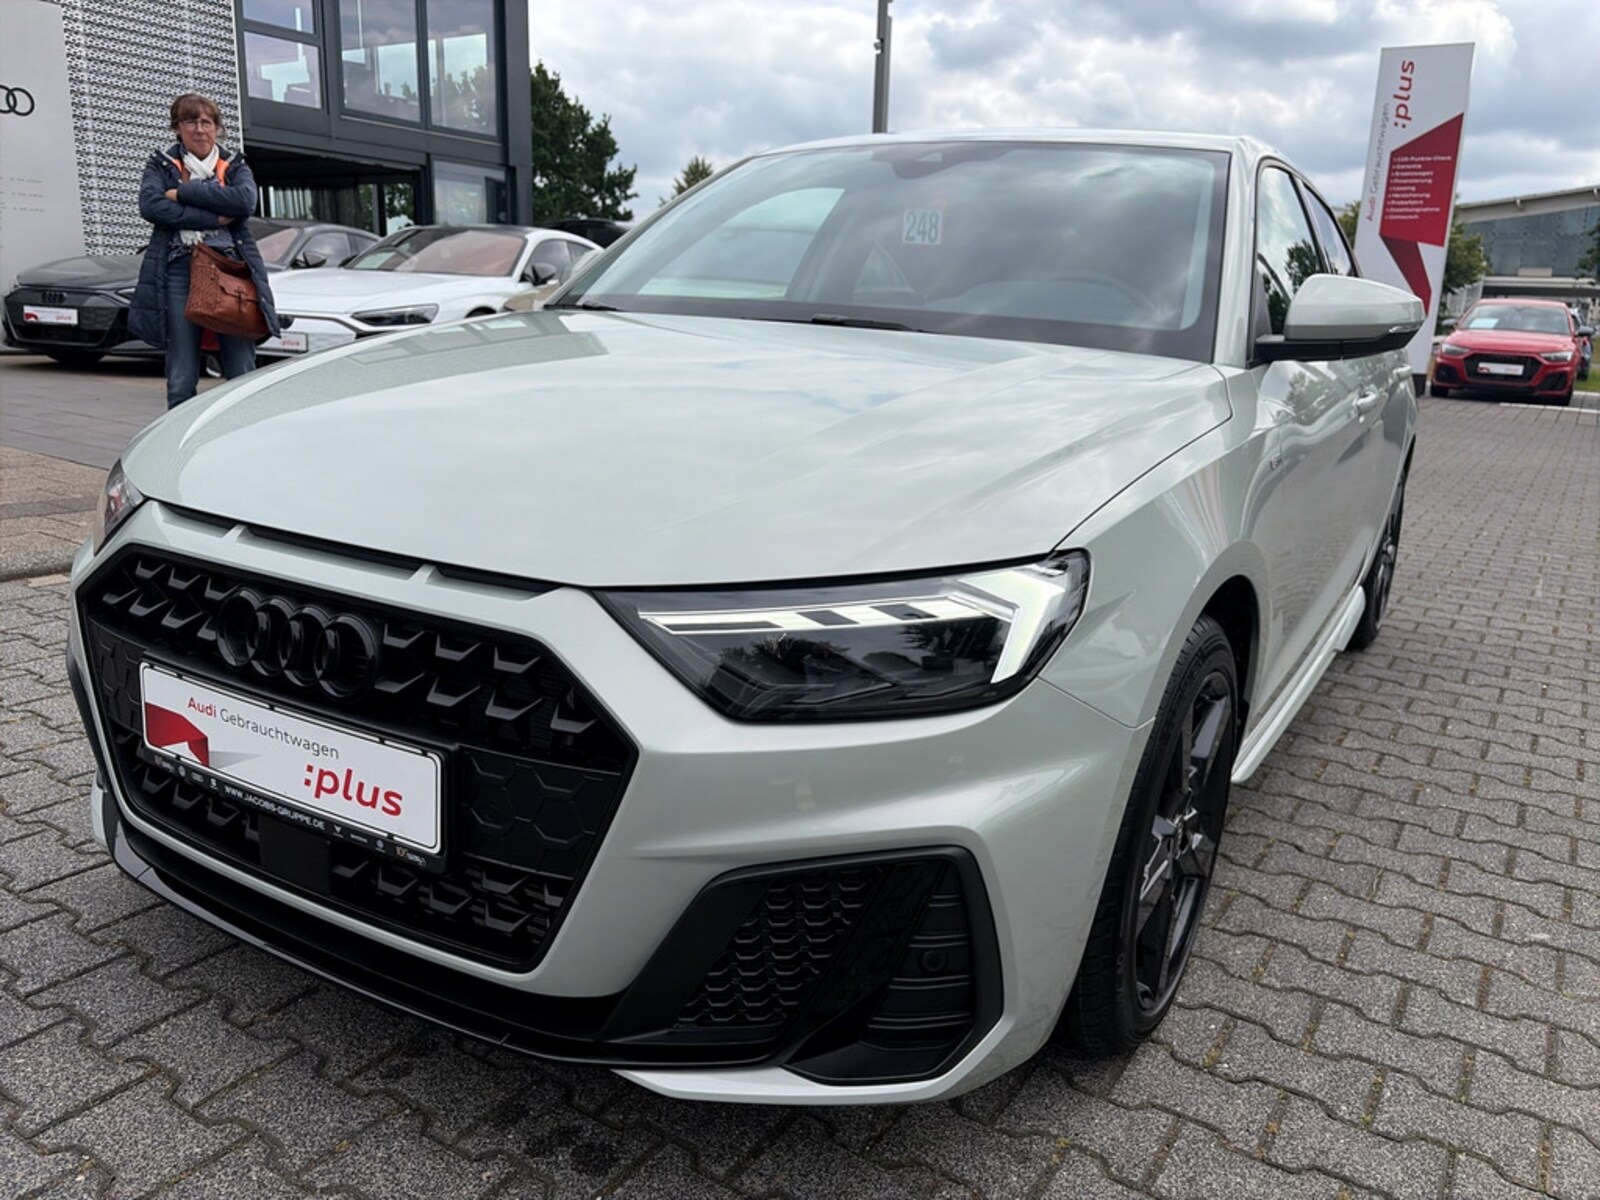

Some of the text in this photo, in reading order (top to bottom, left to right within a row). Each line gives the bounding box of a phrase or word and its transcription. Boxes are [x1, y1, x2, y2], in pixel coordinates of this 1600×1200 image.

[1393, 60, 1415, 129] :plus
[904, 210, 940, 243] 248
[1366, 196, 1376, 221] Audi
[187, 696, 340, 760] Audi Gebrauchtwagen
[303, 763, 404, 818] :plus
